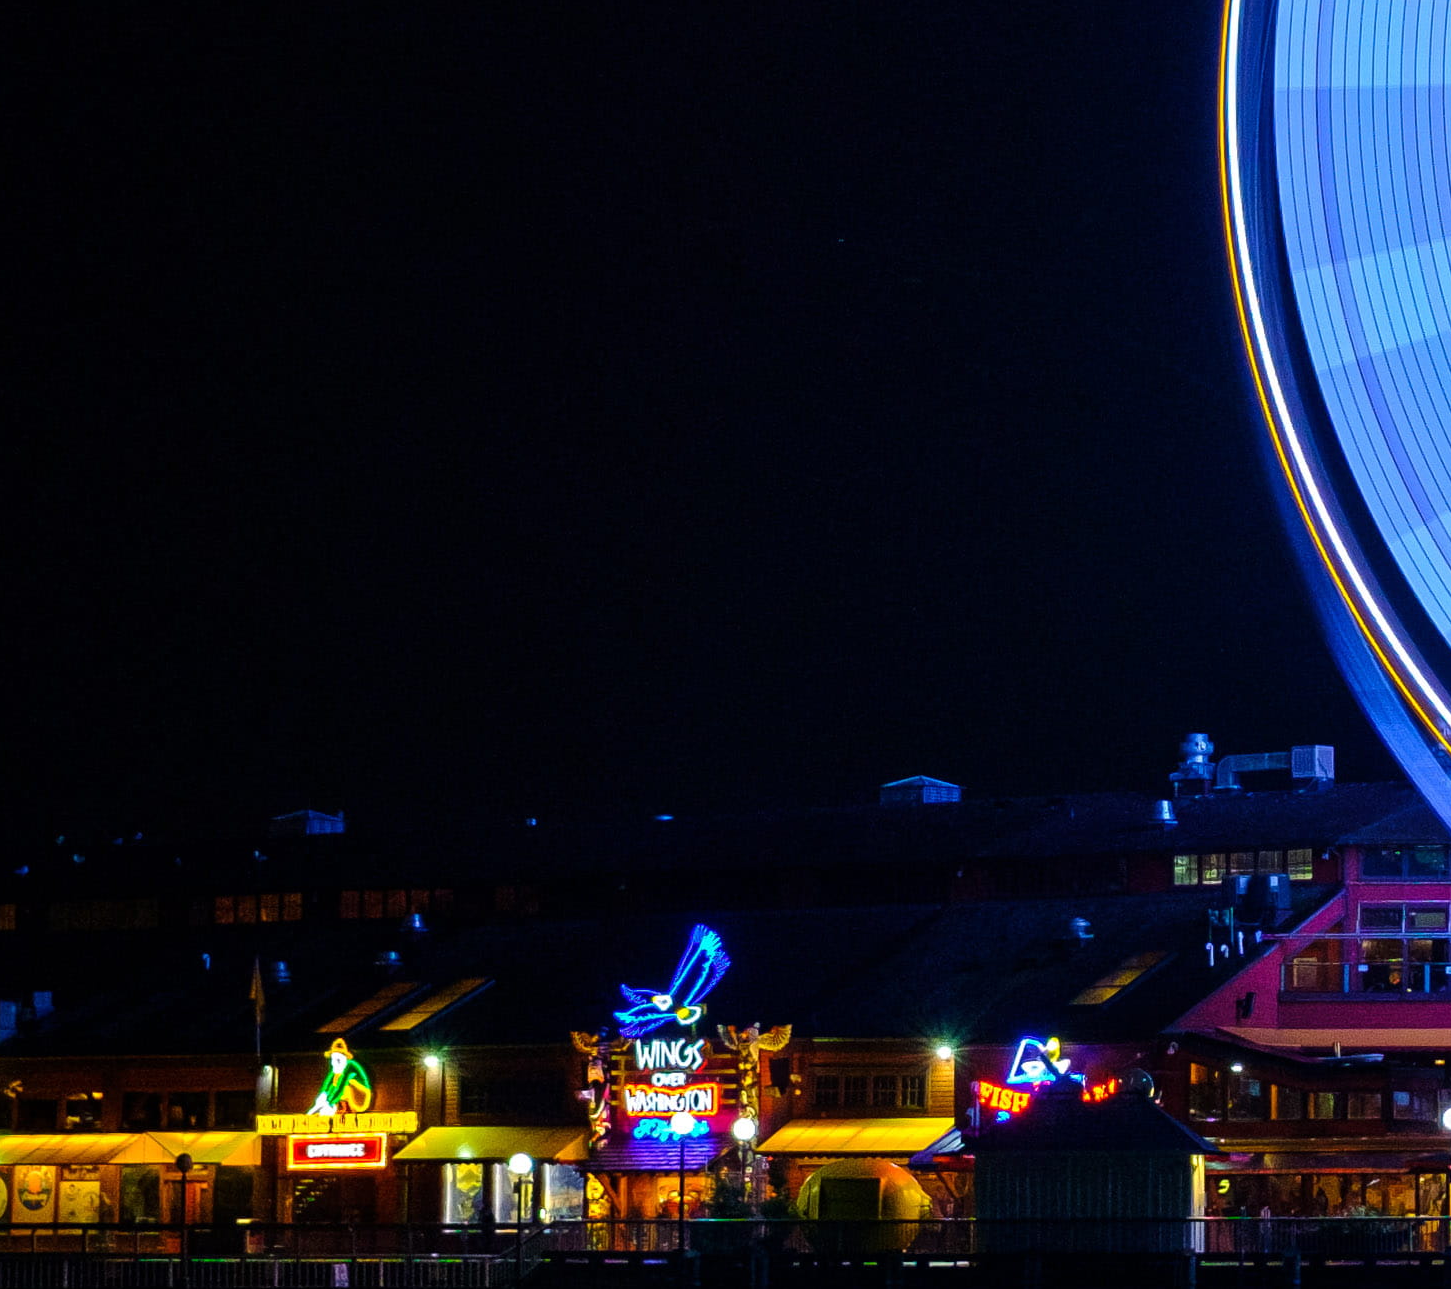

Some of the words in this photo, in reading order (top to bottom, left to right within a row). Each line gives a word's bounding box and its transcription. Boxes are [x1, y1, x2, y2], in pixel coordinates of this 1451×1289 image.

[635, 1038, 706, 1071] WINGS
[651, 1072, 687, 1087] OVER
[625, 1088, 712, 1112] WASHINGTON
